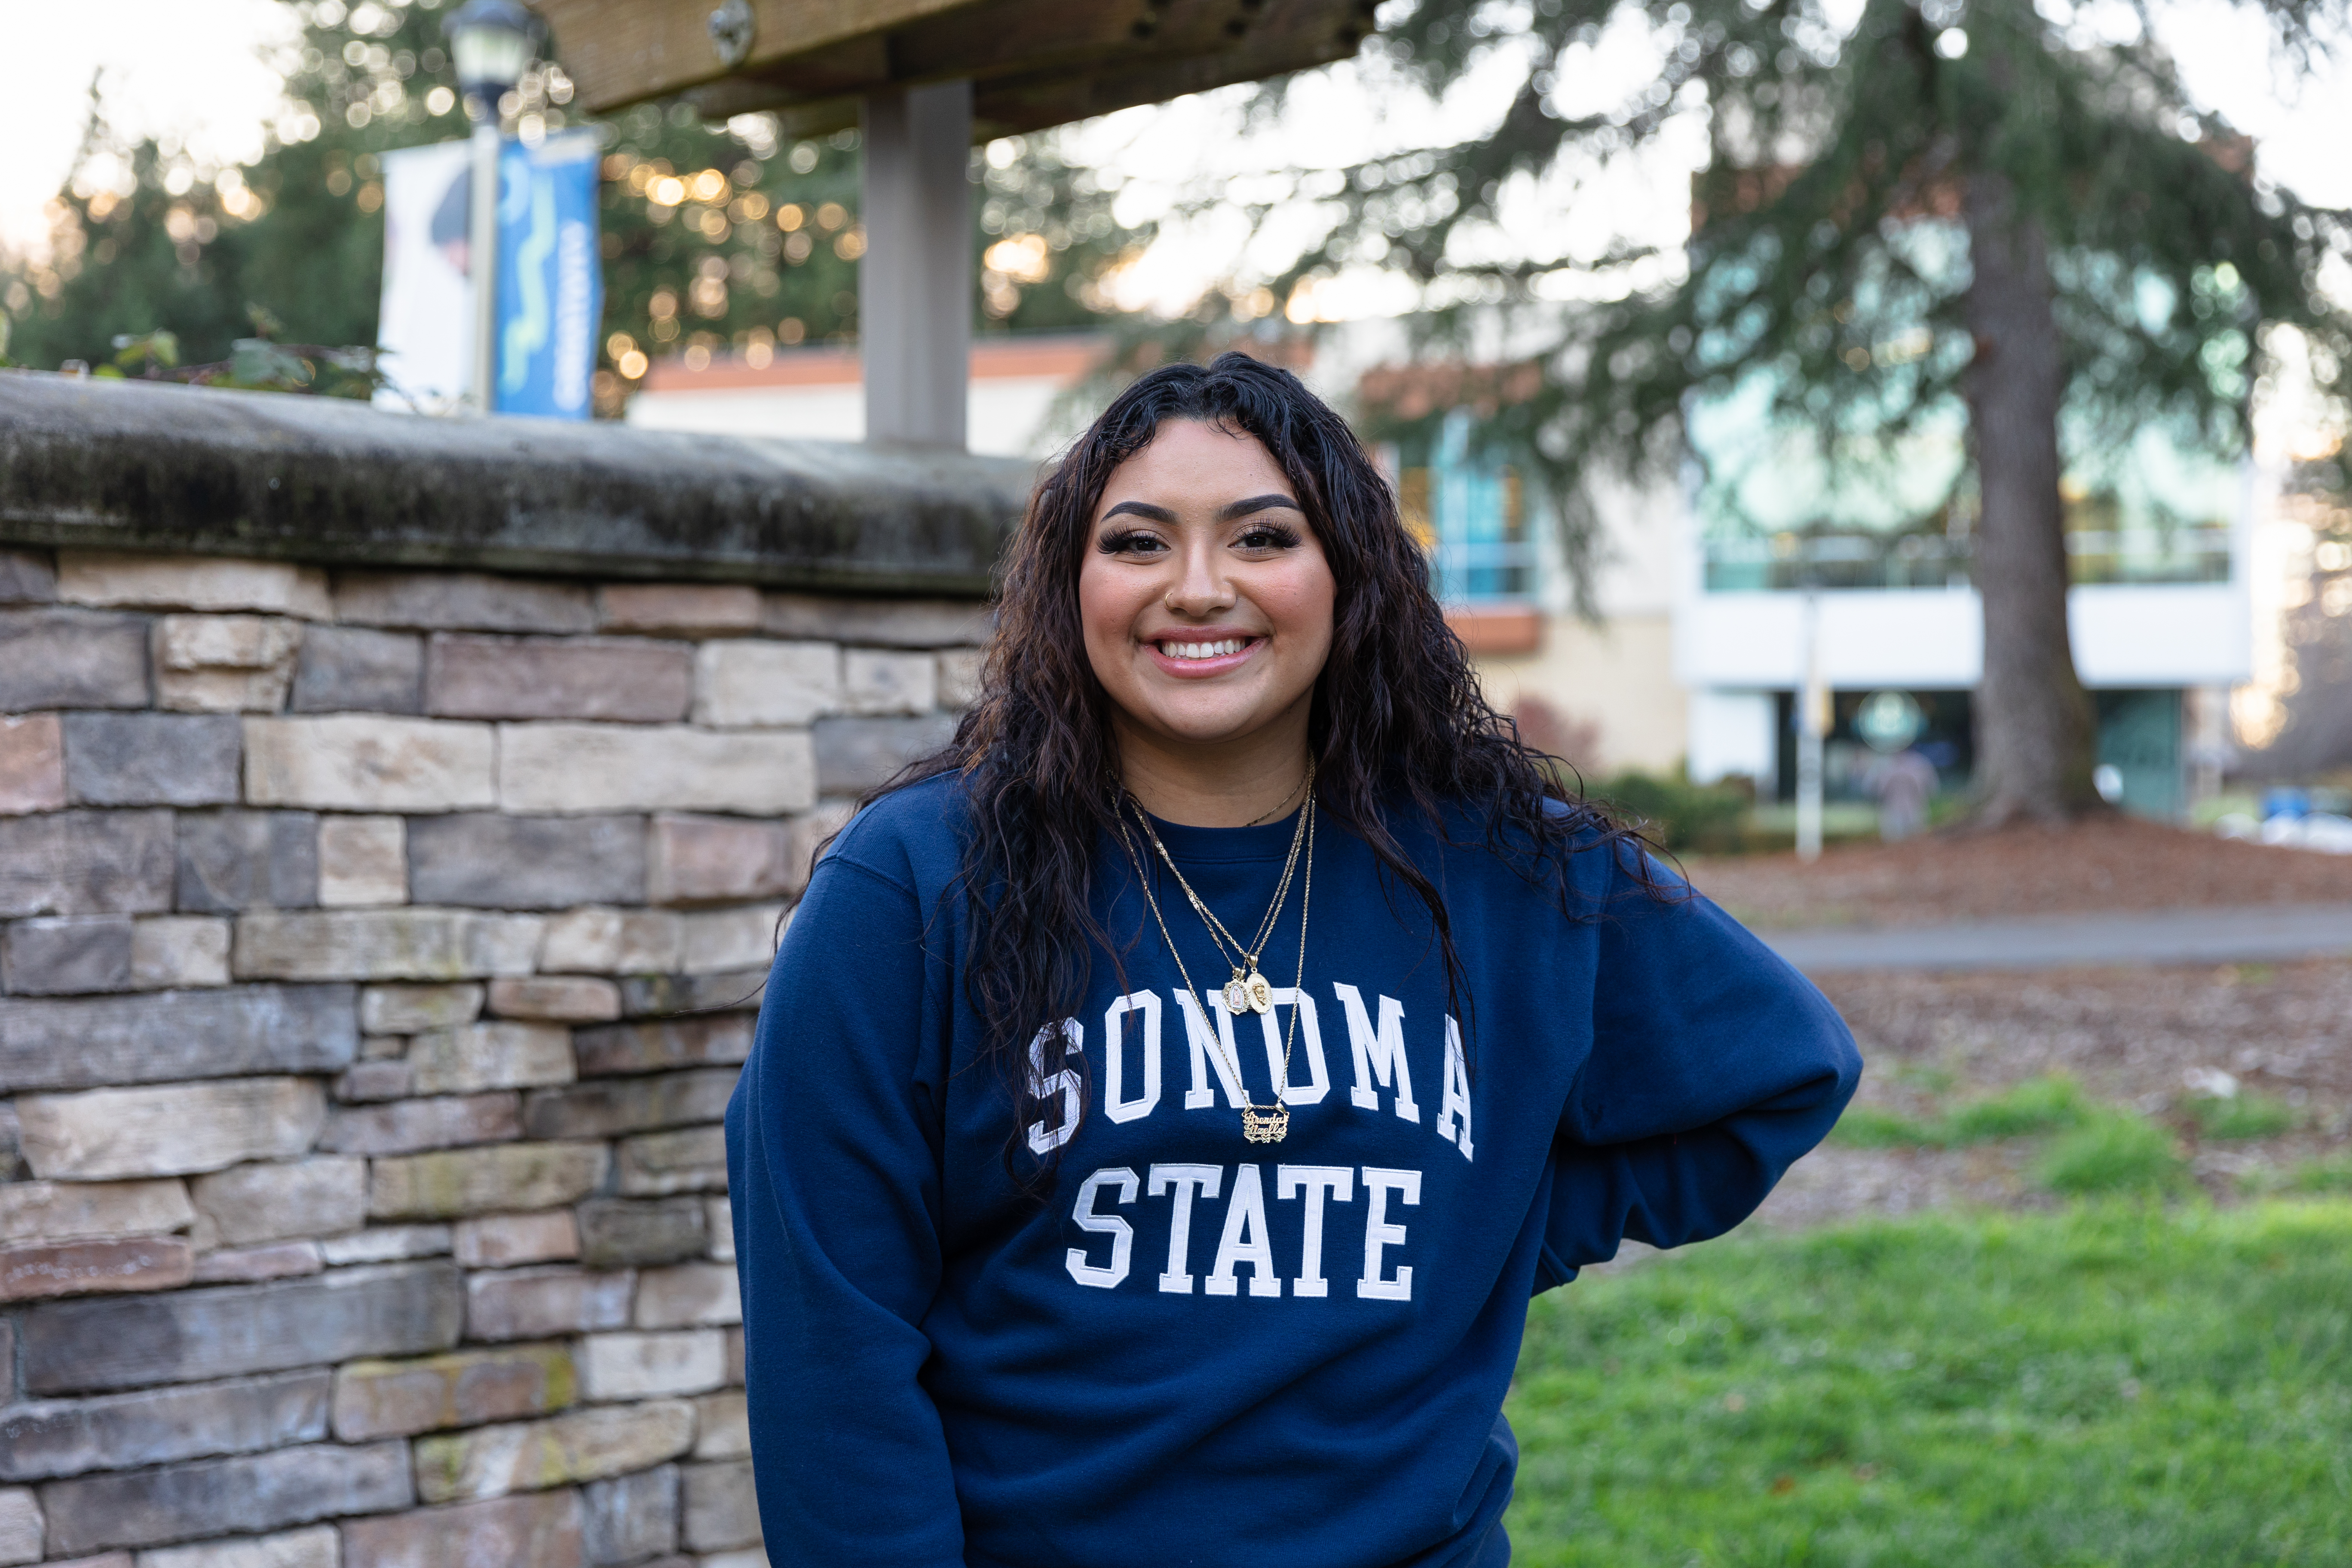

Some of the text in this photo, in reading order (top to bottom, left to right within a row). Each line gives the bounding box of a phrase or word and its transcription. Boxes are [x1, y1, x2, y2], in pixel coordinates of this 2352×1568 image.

[1028, 982, 1474, 1162] SONOMA
[1243, 1111, 1285, 1124] Brenda
[1244, 1123, 1286, 1135] Gizelle
[1065, 1163, 1422, 1301] STATE
